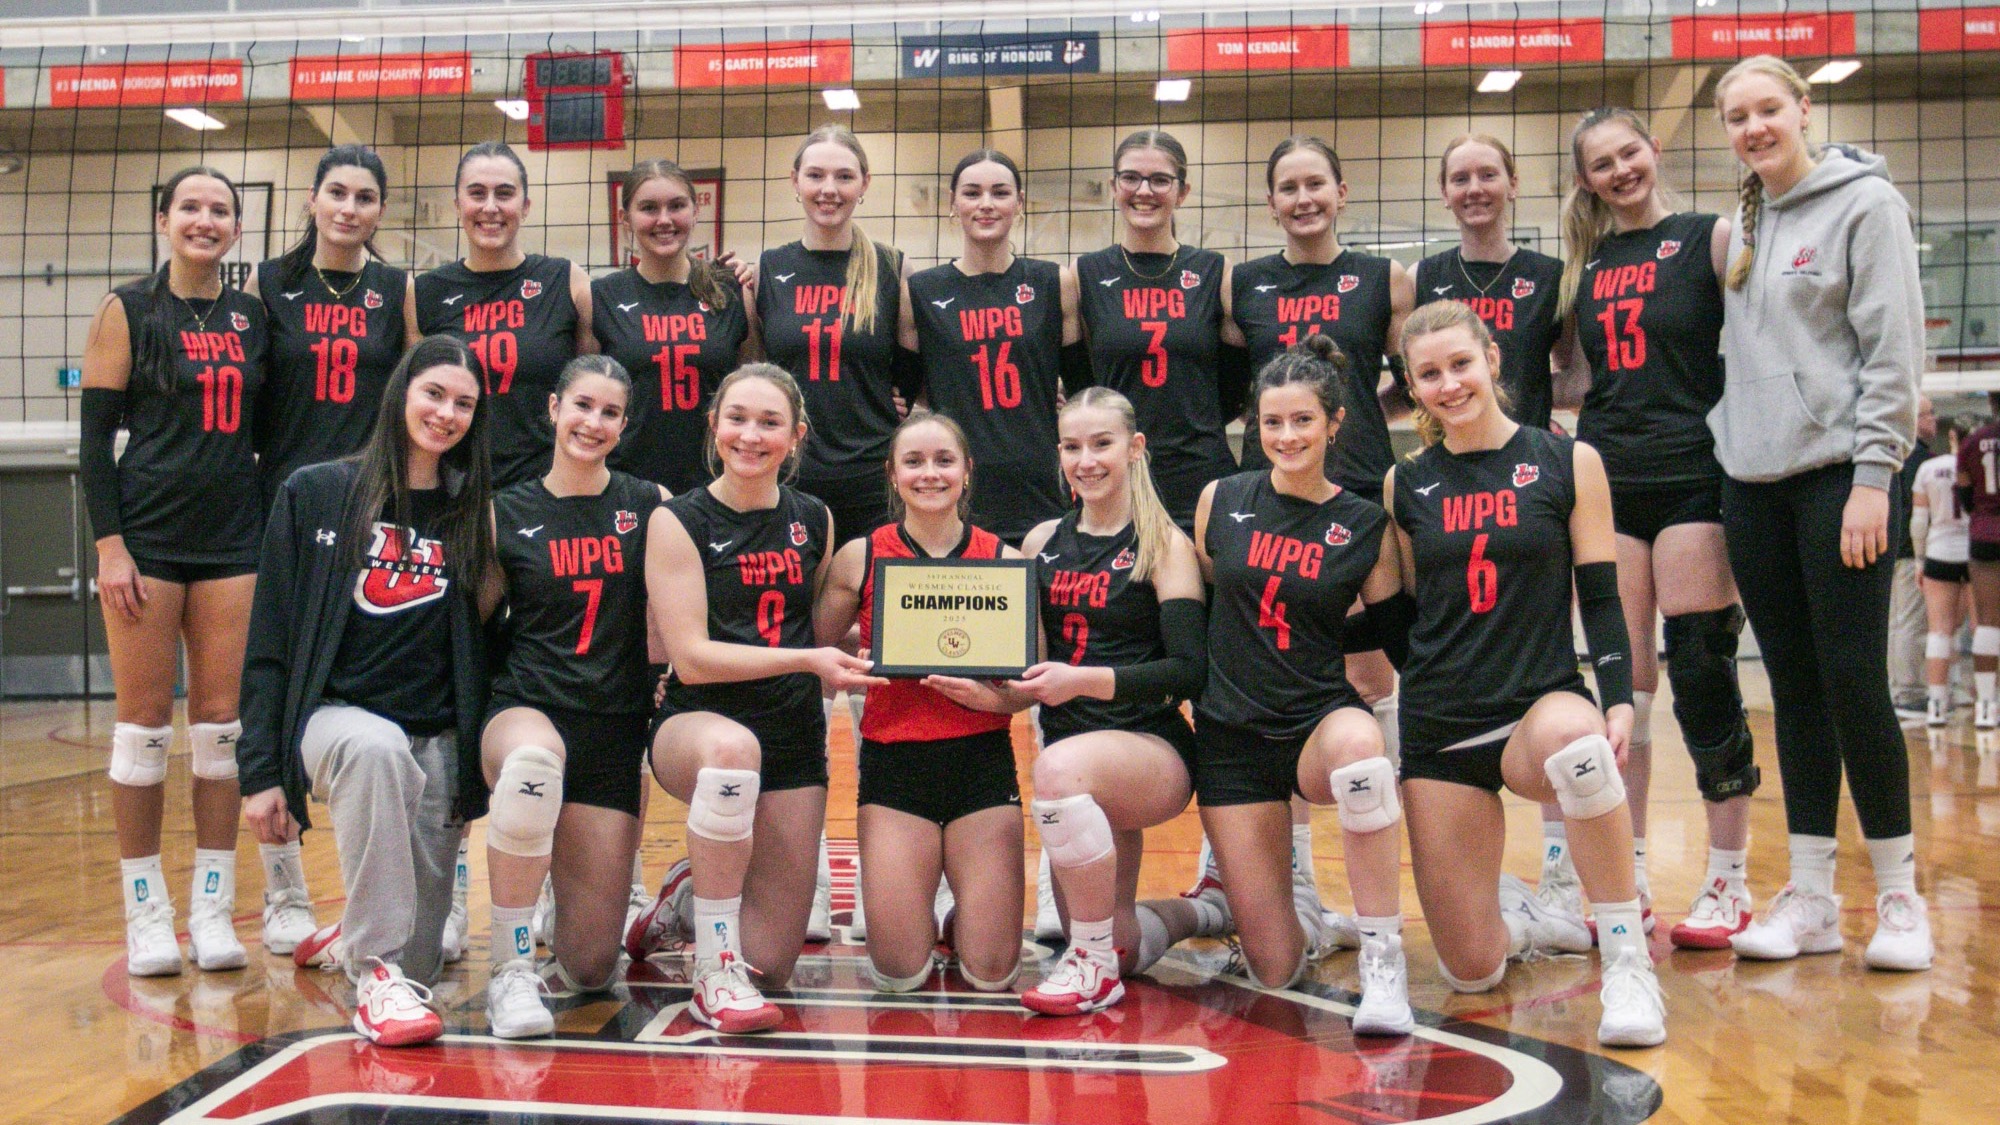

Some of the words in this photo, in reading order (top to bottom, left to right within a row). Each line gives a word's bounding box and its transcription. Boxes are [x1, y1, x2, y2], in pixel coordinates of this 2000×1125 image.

[1217, 42, 1243, 55] TOM
[1247, 40, 1300, 54] KENDALL
[1469, 35, 1515, 49] SANDRA
[1519, 34, 1573, 48] CARROLL
[1775, 26, 1814, 40] SCOTT
[320, 69, 354, 83] JAMIE
[428, 66, 463, 80] JONES
[708, 59, 722, 72] #5
[725, 57, 764, 71] GARTH
[767, 55, 818, 69] PISCHKE
[948, 52, 978, 65] RING
[982, 51, 998, 64] OF
[1001, 50, 1053, 63] HONOUR
[71, 77, 117, 92] BRENDA
[171, 73, 238, 88] WESTWOOD
[1593, 261, 1657, 300] WPG
[304, 303, 367, 338] WPG
[463, 299, 525, 333] WPG
[1122, 287, 1186, 319] WPG
[1277, 293, 1340, 324] WPG
[641, 312, 707, 343] WPG
[959, 305, 1023, 342] WPG
[1597, 297, 1647, 371] 13
[180, 329, 246, 363] WPG
[468, 331, 518, 395] 19
[801, 317, 843, 382] 11
[1140, 321, 1168, 388] 3
[310, 337, 359, 404] 18
[651, 343, 701, 411] 15
[969, 341, 1022, 411] 16
[196, 365, 243, 434] 10
[1442, 488, 1518, 534] WPG
[371, 558, 442, 576] WESMEN
[548, 534, 624, 577] WPG
[737, 547, 804, 586] WPG
[1247, 530, 1325, 581] WPG
[1466, 533, 1498, 614] 6
[901, 594, 1009, 611] CHAMPIONS
[1049, 569, 1112, 609] WPG
[572, 578, 604, 655] 7
[756, 589, 786, 649] 9
[1258, 575, 1292, 650] 4
[1062, 612, 1089, 667] 2
